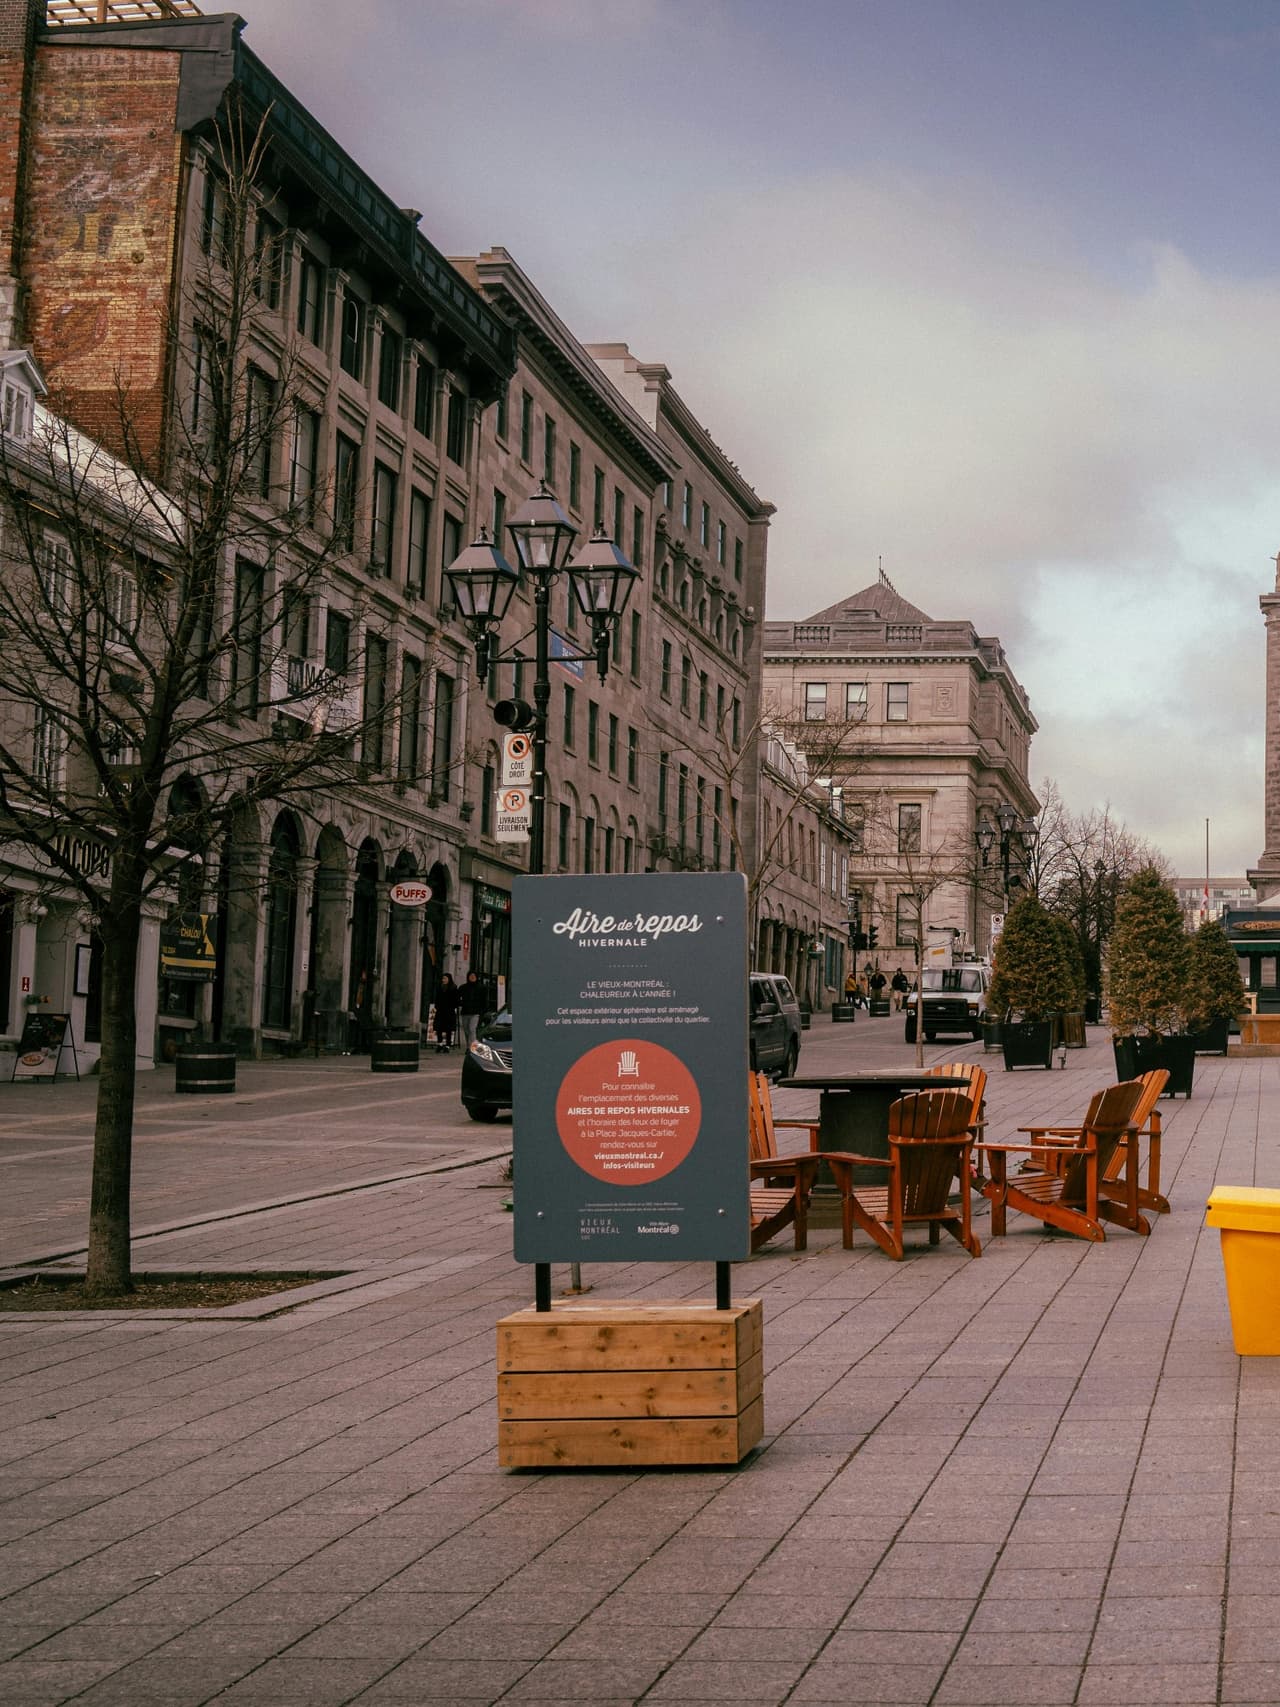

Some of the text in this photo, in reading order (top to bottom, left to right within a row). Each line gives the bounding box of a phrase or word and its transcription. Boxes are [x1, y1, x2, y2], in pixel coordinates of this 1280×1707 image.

[509, 770, 525, 778] DROIT
[396, 889, 427, 899] PUFFS
[553, 908, 703, 940] Aire de repos
[579, 939, 647, 947] HIVERNALE
[599, 980, 664, 988] VIEUX-MONTRÉAL
[580, 991, 630, 999] CHALEUREUX
[632, 990, 638, 998] À
[669, 1007, 699, 1015] aménagé
[545, 1018, 560, 1026] pour
[685, 1016, 710, 1024] quartier.
[602, 1082, 655, 1090] Pour connaître
[579, 1093, 632, 1103] l'emplacement
[595, 1107, 605, 1115] DE
[608, 1107, 635, 1115] REPOS
[638, 1106, 690, 1114] HIVERNALES
[578, 1119, 585, 1127] et
[661, 1118, 679, 1127] foyer
[581, 1129, 586, 1137] à
[618, 1129, 677, 1139] Jacques-Cartier,
[600, 1141, 645, 1149] rendez-vous
[581, 1226, 620, 1234] MONTRÉAL
[638, 1226, 669, 1234] Montréal
